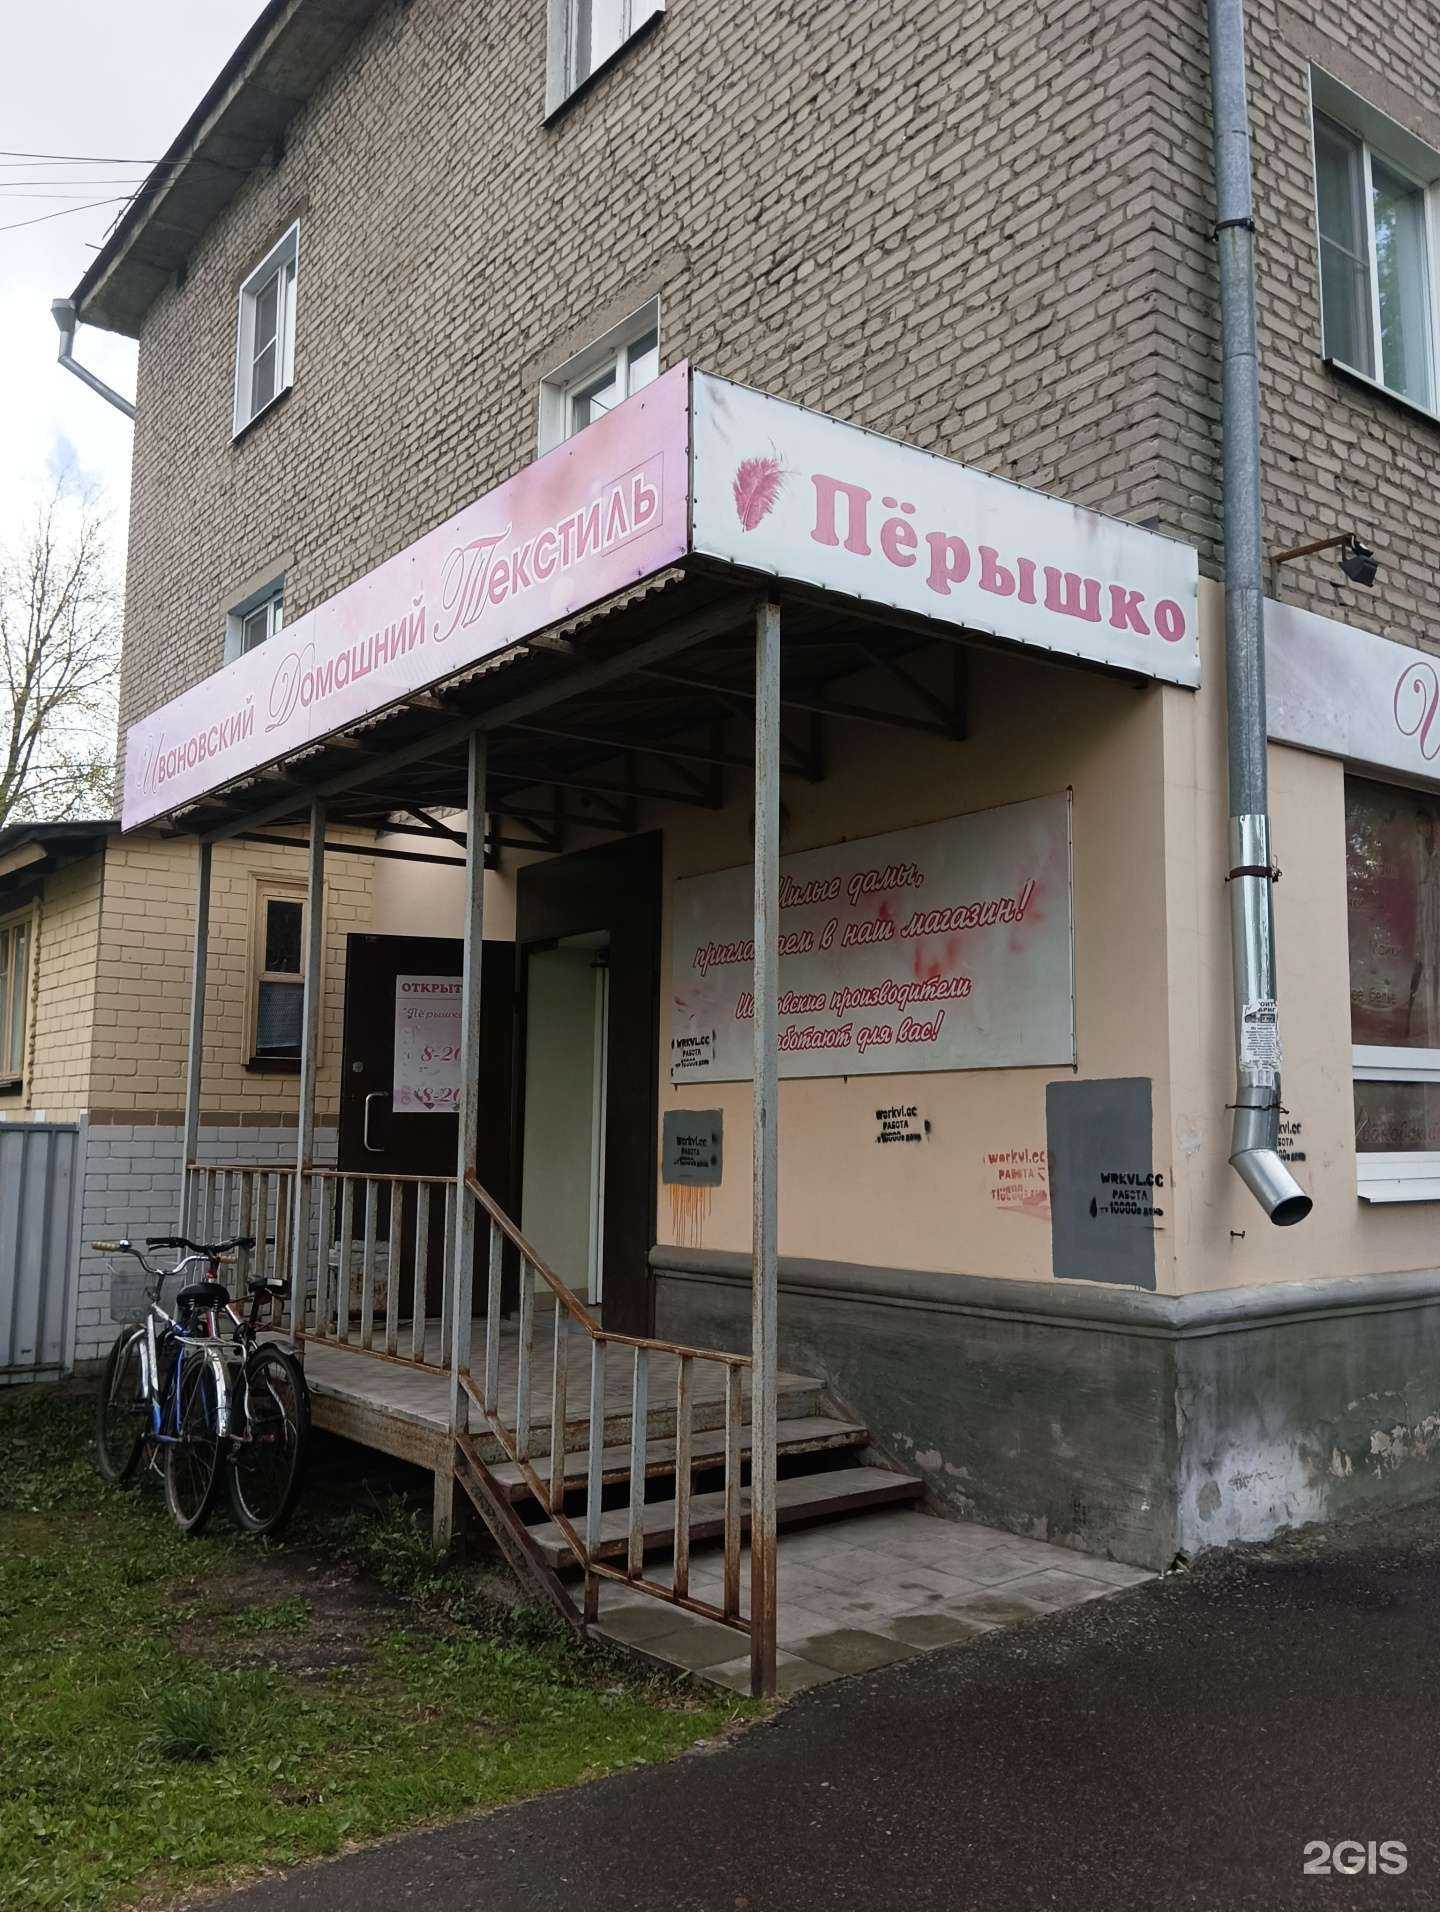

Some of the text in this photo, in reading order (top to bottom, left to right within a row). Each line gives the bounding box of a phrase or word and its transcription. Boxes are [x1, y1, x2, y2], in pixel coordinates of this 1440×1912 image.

[810, 473, 1186, 642] Пёрышко
[143, 476, 657, 794] Ивановский Домашний Текстиль
[847, 862, 924, 907] дамы,
[693, 877, 1035, 977] приглааем в наш магазин!
[401, 983, 463, 994] ОТКРЫТ
[829, 975, 971, 1018] производители
[857, 1023, 892, 1054] для
[897, 1009, 945, 1043] вас!
[1112, 1189, 1148, 1200] РАБОТА
